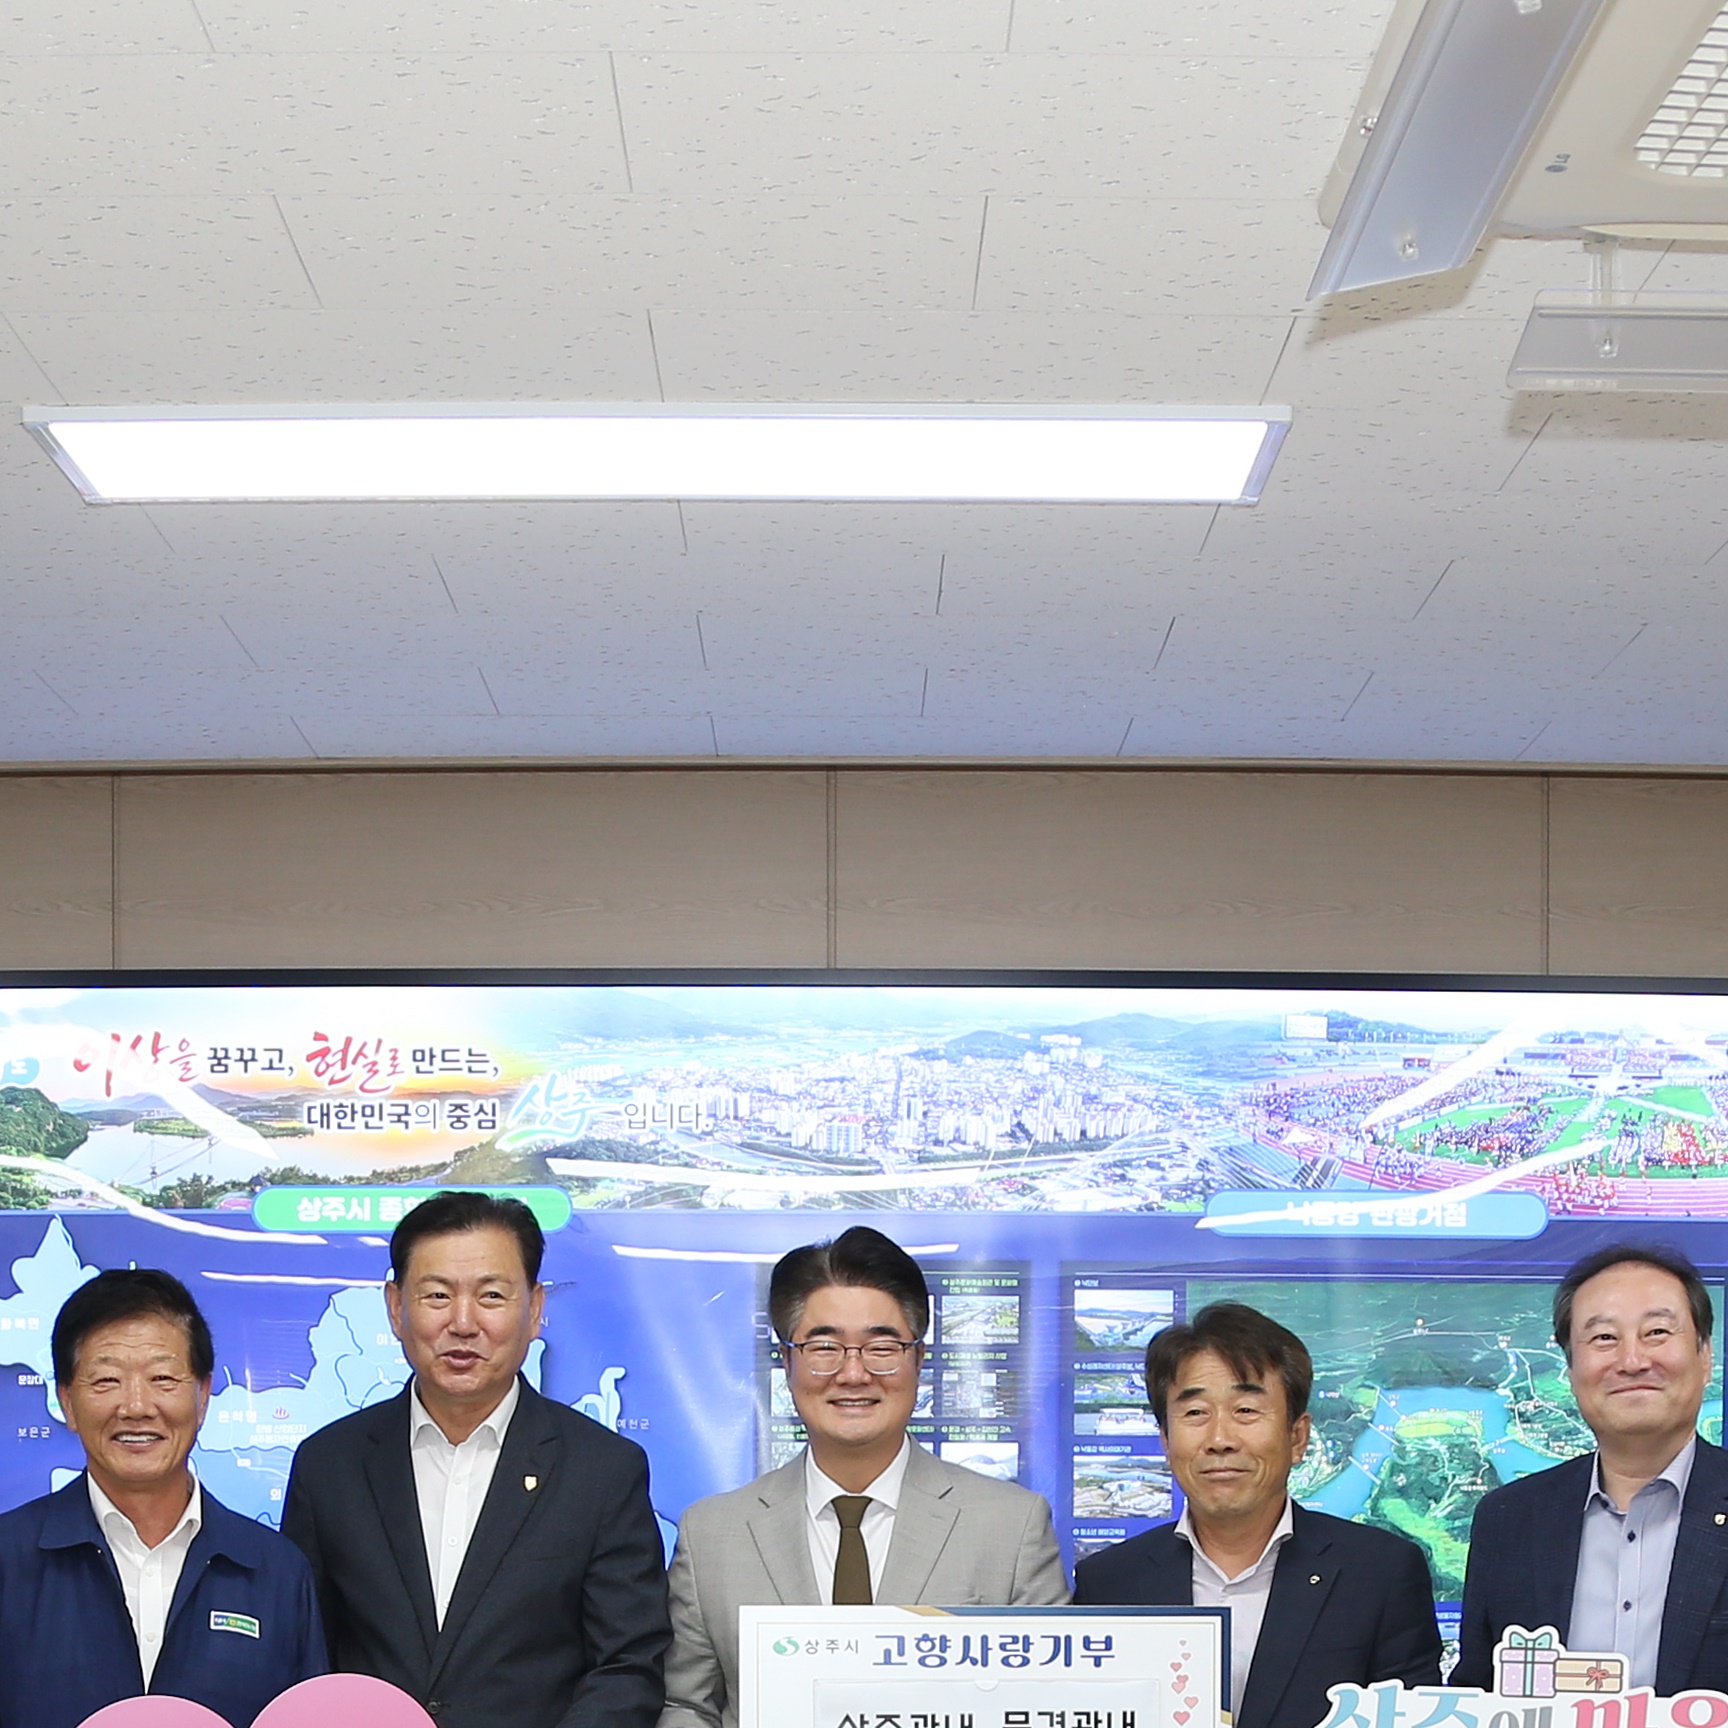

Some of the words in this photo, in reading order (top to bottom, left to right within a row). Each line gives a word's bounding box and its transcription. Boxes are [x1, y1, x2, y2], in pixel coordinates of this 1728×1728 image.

[74, 1031, 200, 1098] 이상을
[207, 1046, 294, 1077] 꿈꾸고,
[305, 1030, 405, 1094] 현실로
[412, 1046, 500, 1077] 만드는,
[306, 1101, 437, 1130] 대한민국의
[446, 1101, 498, 1130] 중심
[509, 1073, 600, 1142] 상주
[624, 1102, 713, 1131] 입니다.
[296, 1196, 371, 1223] 상주시
[17, 1426, 51, 1439] 보은군
[616, 1418, 650, 1431] 예천군
[804, 1638, 860, 1655] 상주시
[871, 1632, 1117, 1669] 고향사랑기부
